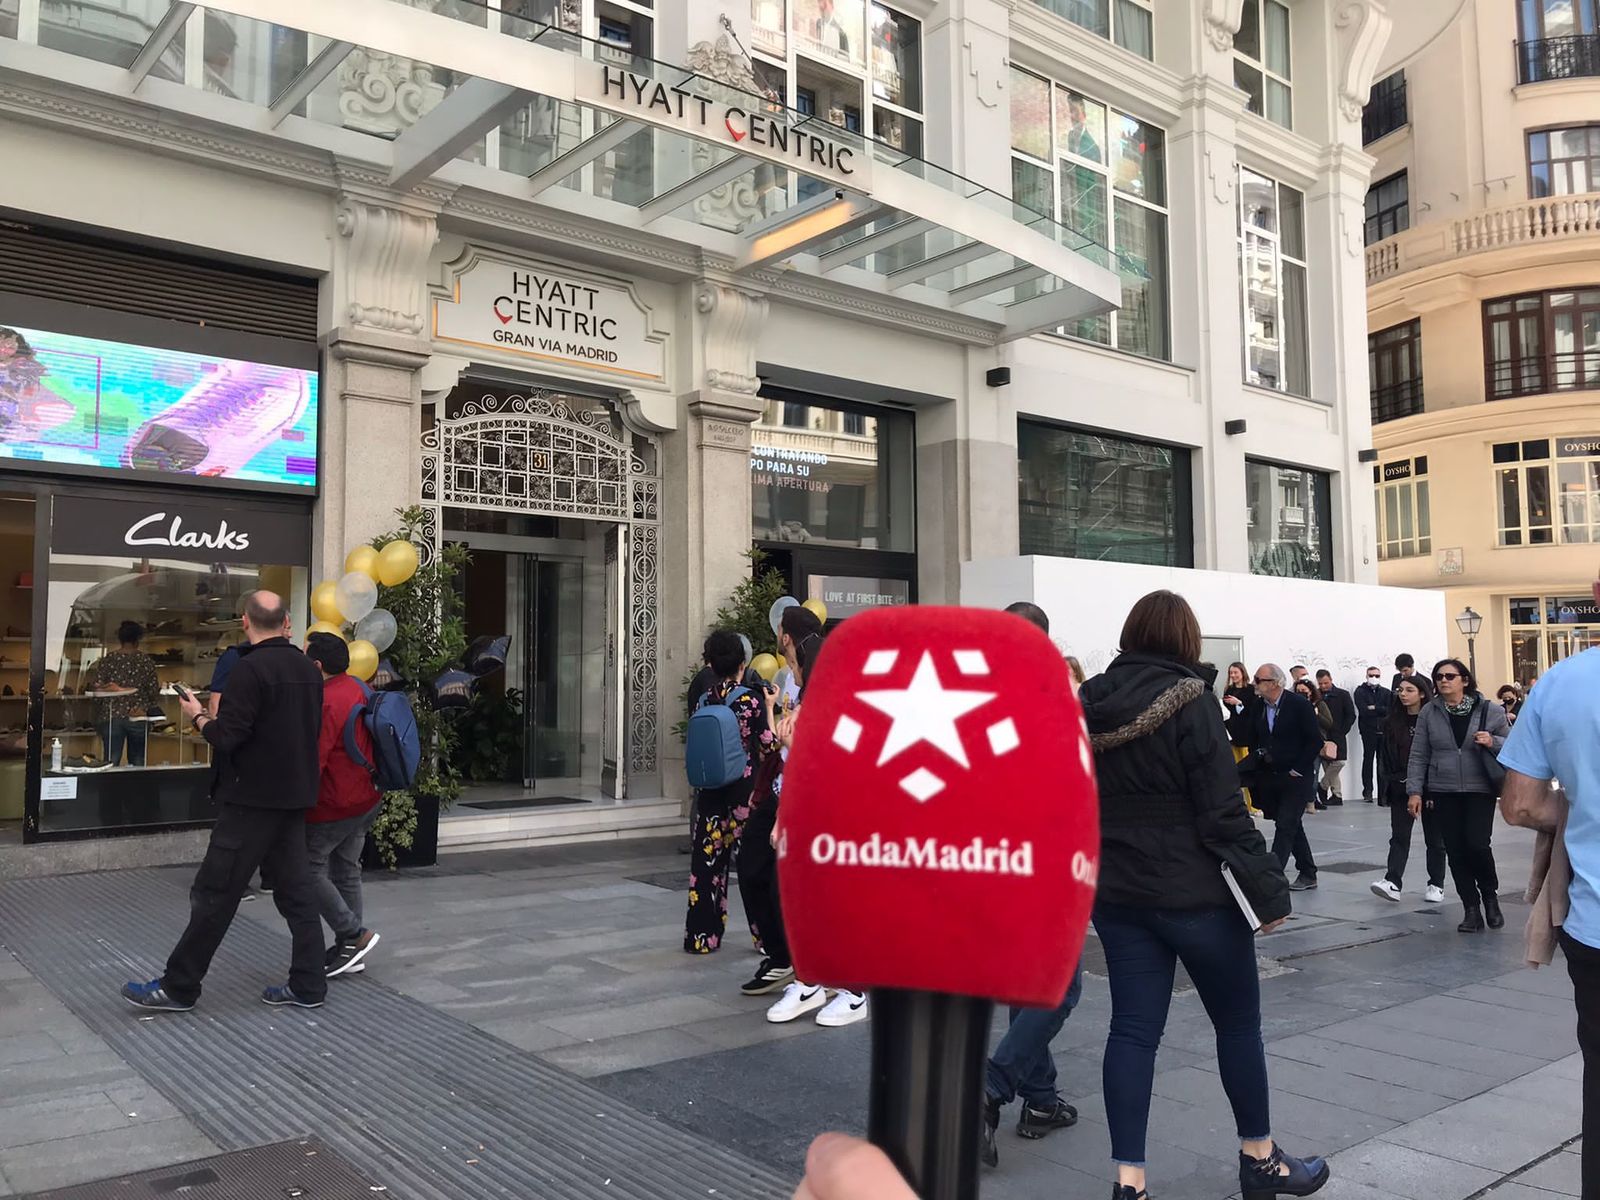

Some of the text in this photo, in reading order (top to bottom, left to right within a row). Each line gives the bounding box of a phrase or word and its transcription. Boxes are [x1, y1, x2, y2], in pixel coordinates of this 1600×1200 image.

[603, 65, 854, 174] HYATT CENTRIC
[513, 271, 599, 310] HYATT
[493, 296, 617, 341] CENTRIC
[493, 330, 618, 363] GRAN VIA MADRID
[534, 453, 547, 469] 31
[754, 447, 828, 465] CONTRATANDO
[766, 460, 795, 475] PARA
[796, 464, 810, 477] SU
[1385, 465, 1410, 477] OYSHO
[752, 473, 829, 493] IMA APERTURA
[124, 512, 250, 550] Clarks
[825, 591, 893, 605] LOVE AT FIRST BITE
[1561, 605, 1600, 615] OYSHO
[811, 832, 1033, 875] OndaMadrid
